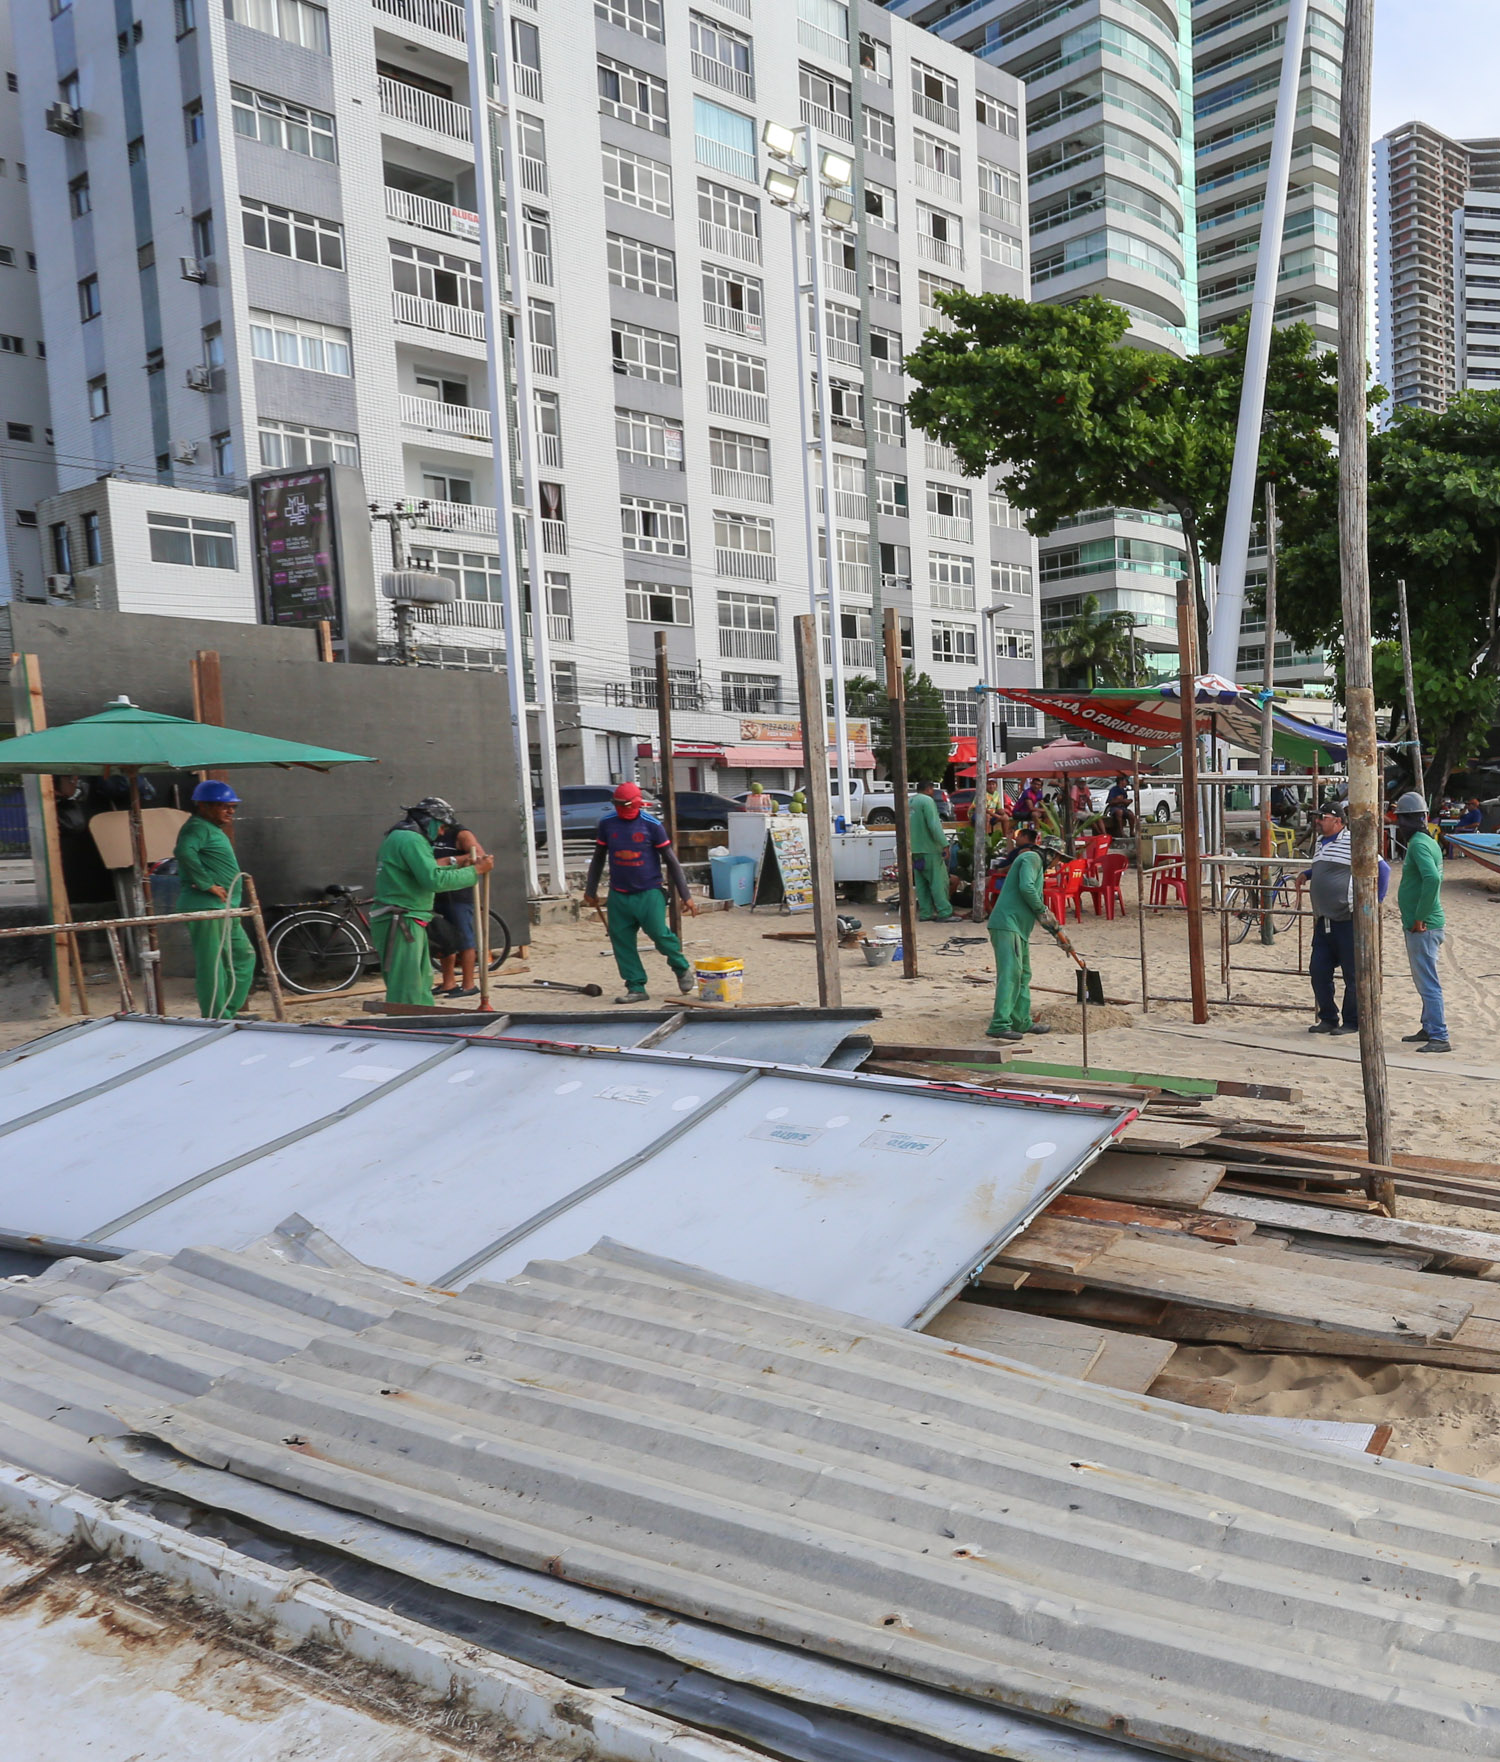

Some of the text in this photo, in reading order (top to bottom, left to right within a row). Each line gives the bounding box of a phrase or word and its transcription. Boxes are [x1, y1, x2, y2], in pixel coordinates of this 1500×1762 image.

[762, 723, 796, 731] PIZZARIA
[1081, 709, 1096, 718] O
[1093, 713, 1138, 734] FARIAS
[1135, 726, 1168, 740] BRITO
[1054, 757, 1102, 768] ITAIPAVA
